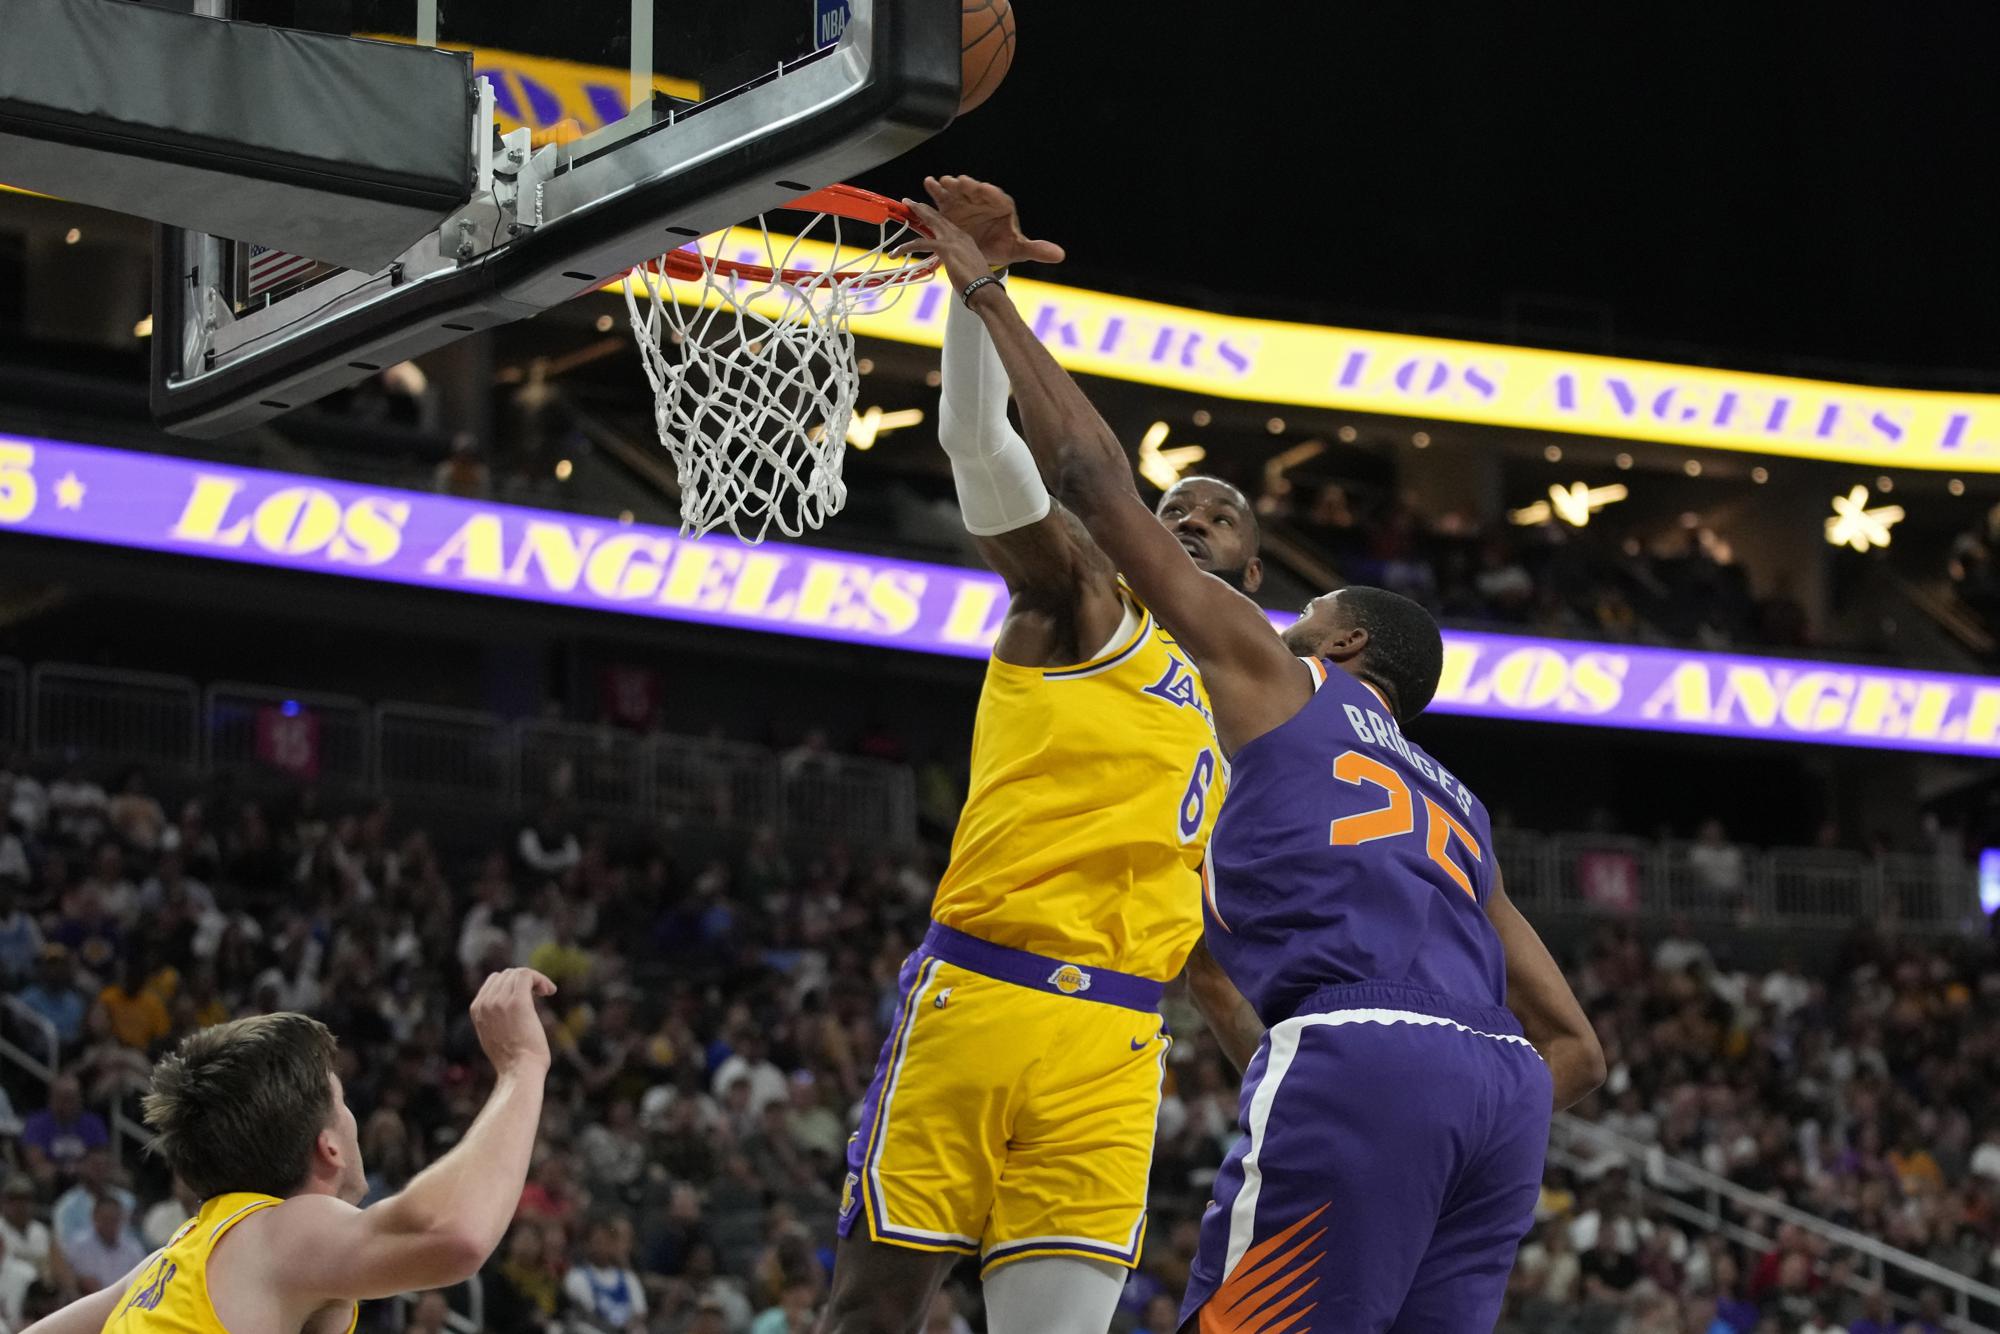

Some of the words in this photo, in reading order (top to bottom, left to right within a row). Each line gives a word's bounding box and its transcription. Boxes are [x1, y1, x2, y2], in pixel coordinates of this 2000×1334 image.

[821, 6, 846, 43] NBA
[1336, 350, 1500, 402] LOS
[1529, 372, 1912, 443] ANGELES
[172, 473, 411, 566] LOS
[424, 511, 927, 636] ANGELES
[1428, 640, 1629, 715] LOS
[1178, 748, 1215, 844] 6
[1343, 703, 1472, 816] BRIDGES
[1329, 750, 1481, 902] 25
